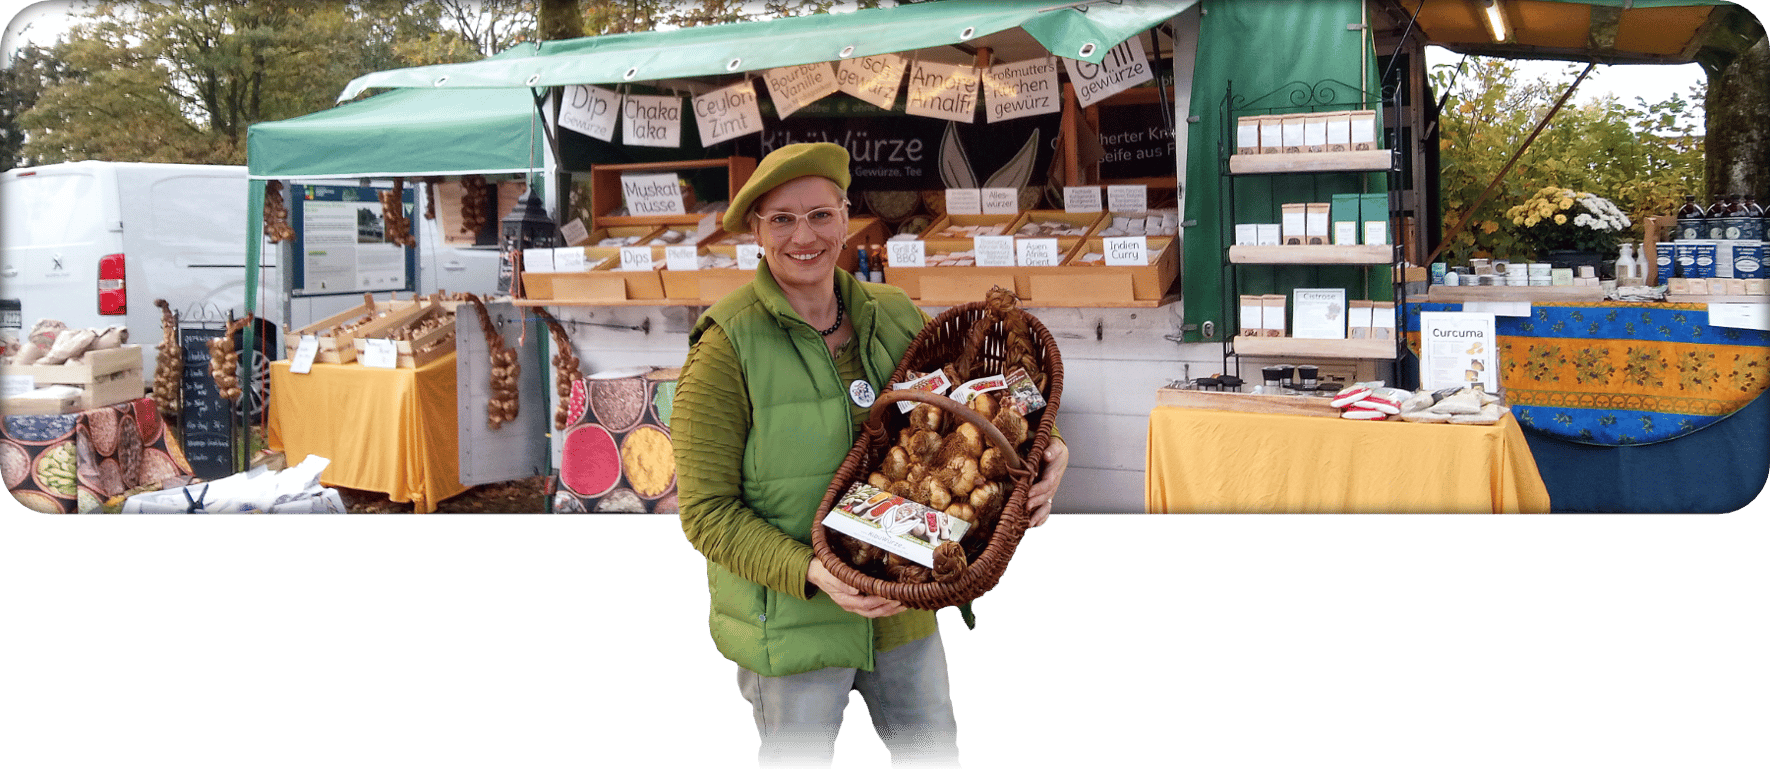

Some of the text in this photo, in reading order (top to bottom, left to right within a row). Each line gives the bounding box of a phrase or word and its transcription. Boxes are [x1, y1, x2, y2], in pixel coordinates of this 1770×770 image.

[912, 66, 976, 93] Amore
[990, 63, 1055, 81] roßmutters
[780, 73, 823, 99] Vanille
[1080, 62, 1144, 101] gewürze
[571, 85, 607, 121] Dip
[624, 99, 679, 121] Chaka
[695, 90, 754, 118] Ceylon
[995, 95, 1050, 119] gewürz
[632, 121, 667, 140] laka
[708, 113, 749, 139] Zimt
[1136, 147, 1162, 160] aus
[904, 165, 923, 177] Tee
[625, 181, 679, 198] Muskat
[634, 197, 676, 212] nüsse
[911, 243, 918, 253] &
[1110, 241, 1139, 250] Indien
[624, 250, 649, 266] Dips
[896, 253, 917, 263] BBQ
[1112, 249, 1139, 261] Curry
[1303, 292, 1336, 300] Cistrose
[1432, 328, 1484, 339] Curcuma
